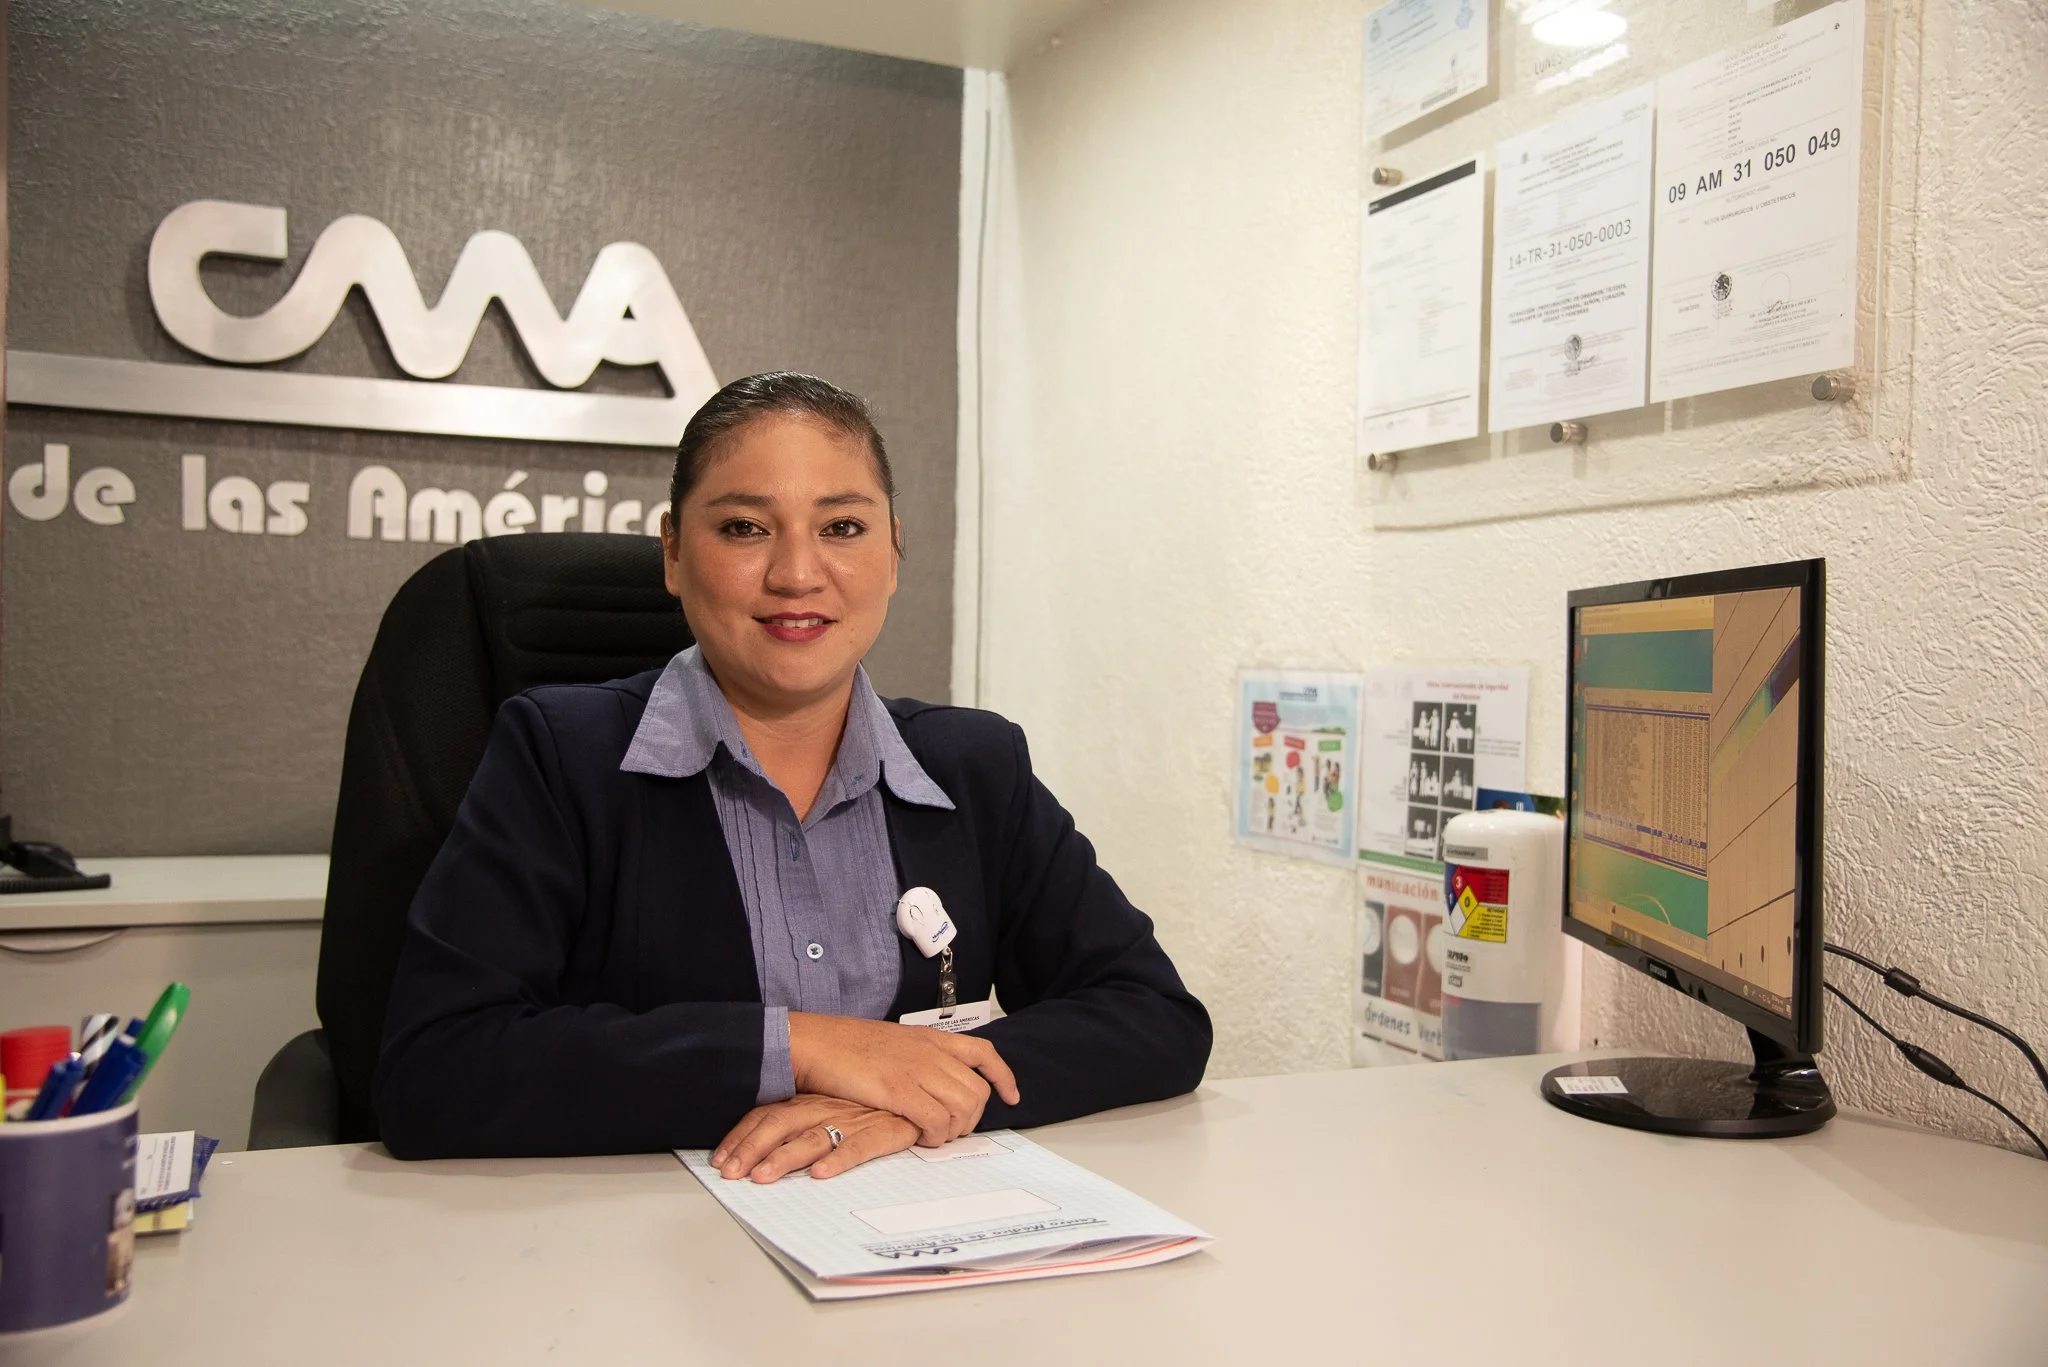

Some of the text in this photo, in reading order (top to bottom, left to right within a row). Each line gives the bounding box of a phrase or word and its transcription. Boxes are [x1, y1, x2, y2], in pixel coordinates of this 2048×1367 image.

[1668, 127, 1841, 203] 09 AM 31 050 049
[1508, 218, 1631, 270] 14-TR-31-050-0003
[148, 199, 722, 398] CMA
[8, 444, 136, 525] de
[181, 453, 310, 536] las
[1455, 876, 1462, 889] 3
[1464, 896, 1470, 908] 0
[968, 1232, 986, 1240] de
